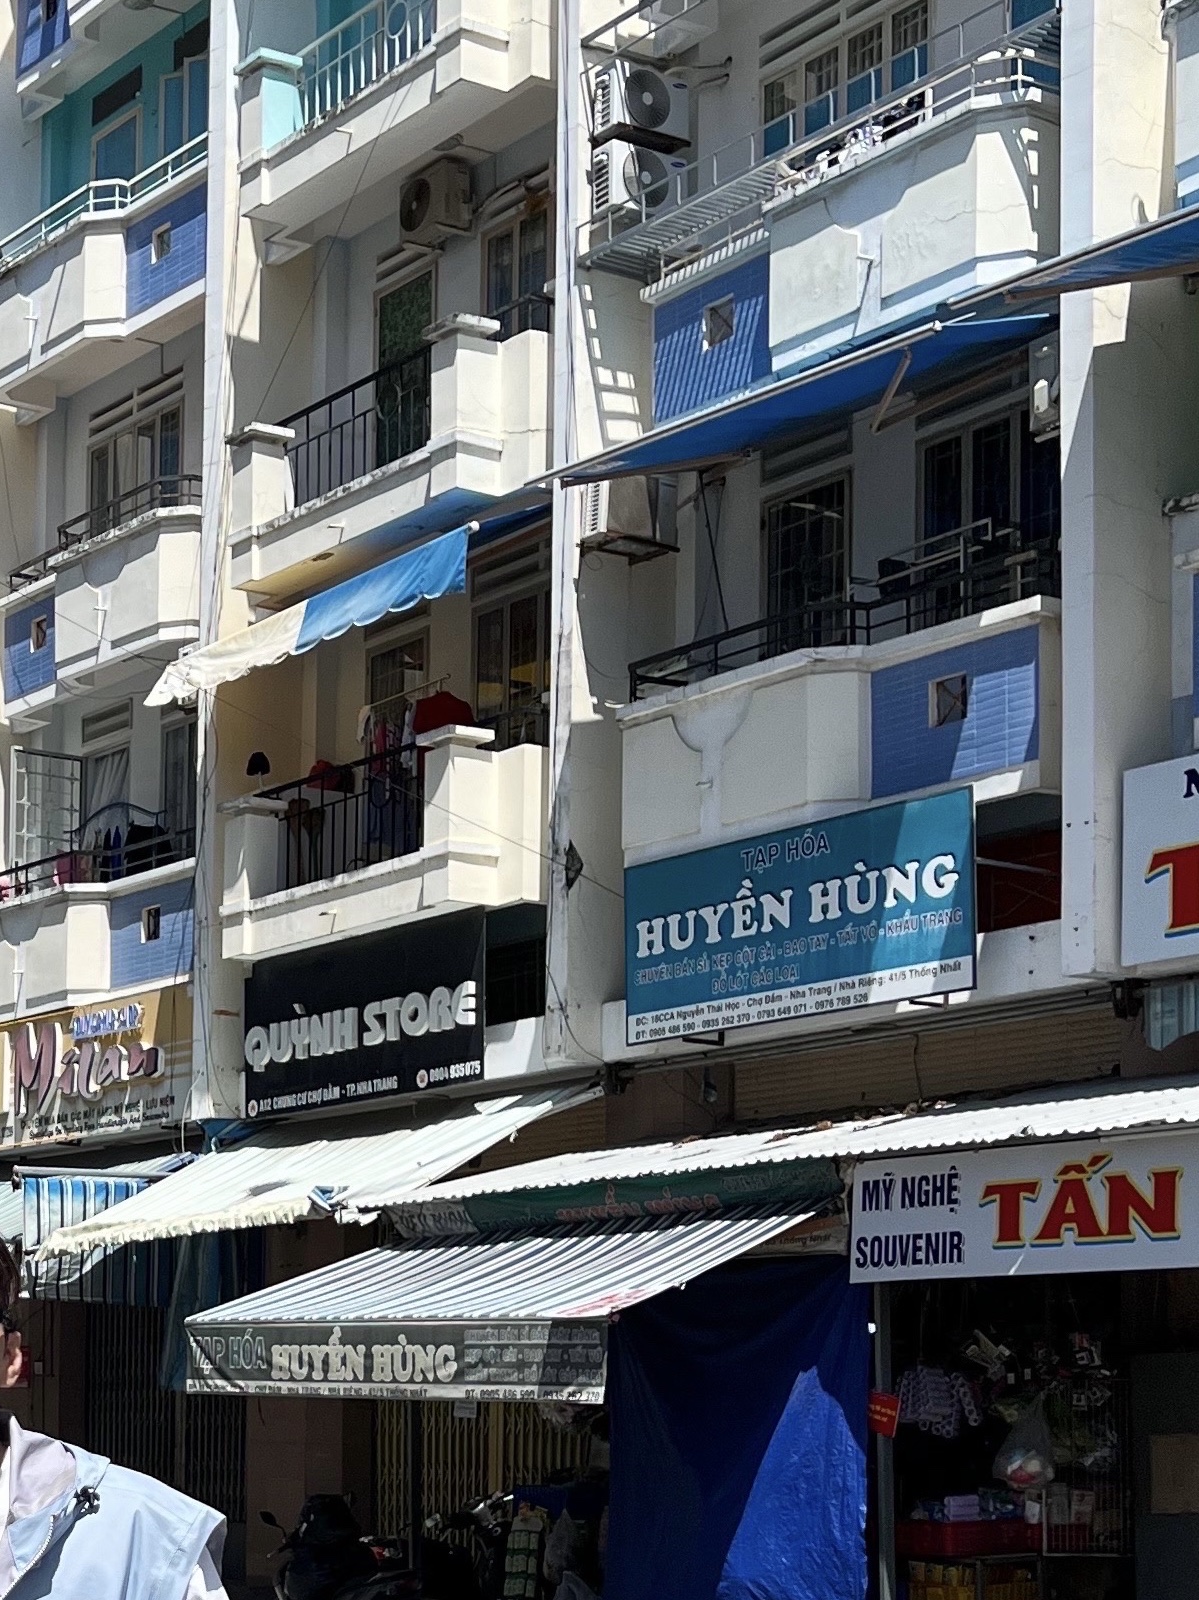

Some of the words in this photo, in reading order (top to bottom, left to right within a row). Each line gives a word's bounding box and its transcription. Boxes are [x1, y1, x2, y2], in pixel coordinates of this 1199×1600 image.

[741, 842, 780, 874] TẠP
[786, 828, 830, 862] HÓA
[636, 878, 793, 958] HUYỀN
[808, 853, 960, 923] HÙNG
[783, 937, 808, 957] BAO
[808, 932, 829, 952] TAY
[920, 907, 963, 931] TRANG
[751, 965, 773, 987] CÁC
[790, 989, 806, 1000] Nha
[808, 985, 832, 998] Trang
[839, 980, 856, 991] Nhà
[939, 960, 962, 974] Nhất
[245, 1002, 358, 1072] QUỲNH
[363, 980, 476, 1046] STORE
[736, 1012, 751, 1022] 370
[756, 1009, 776, 1020] 0793
[793, 1002, 807, 1013] 071
[814, 998, 834, 1010] 0976
[373, 1075, 399, 1092] TRANG
[862, 1172, 895, 1213] MỸ
[901, 1165, 962, 1214] NGHỆ
[979, 1152, 1184, 1249] TẤN
[855, 1231, 965, 1269] SOUVENIR
[229, 1329, 267, 1370] HÓA
[270, 1326, 366, 1382] HUYỀN
[371, 1334, 458, 1382] HÙNG
